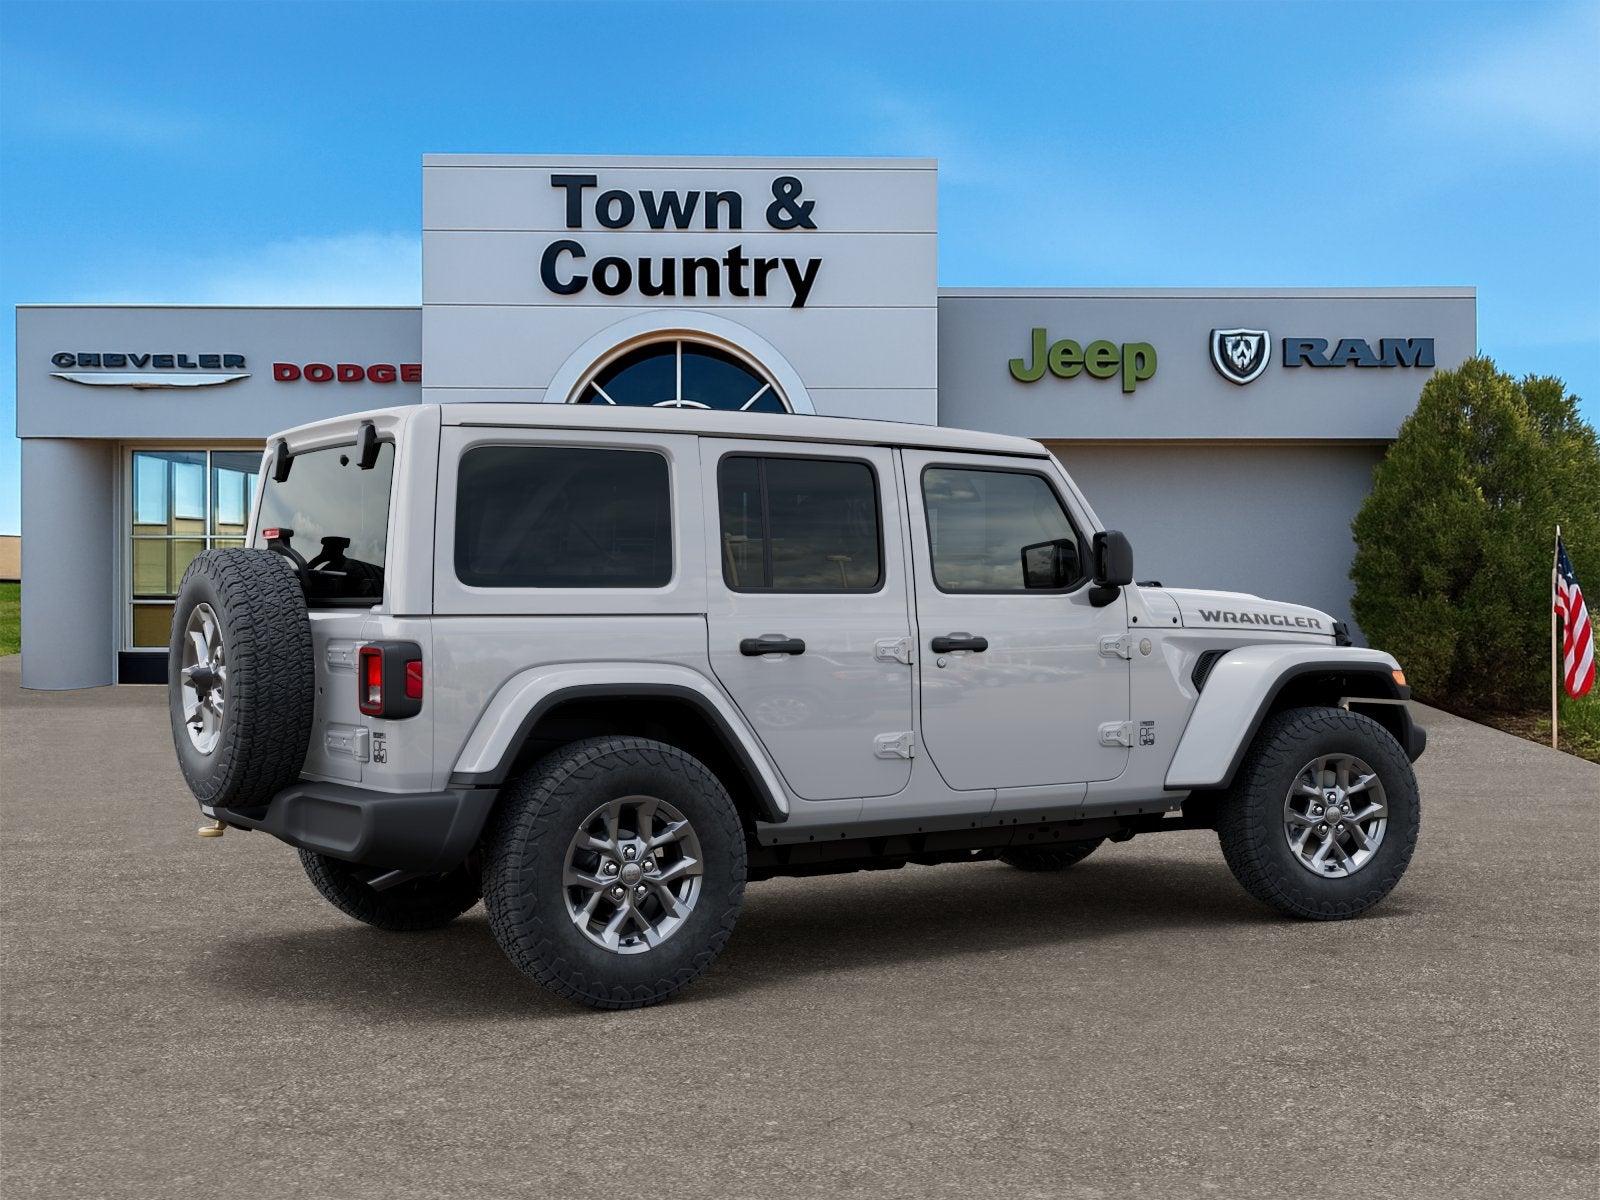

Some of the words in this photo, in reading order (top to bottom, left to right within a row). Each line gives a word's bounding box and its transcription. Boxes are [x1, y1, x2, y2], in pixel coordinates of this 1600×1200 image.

[550, 174, 743, 229] Town
[765, 176, 818, 230] &
[540, 239, 822, 308] Country
[273, 362, 422, 383] DODGE
[1009, 327, 1157, 393] Jeep
[1282, 337, 1436, 368] RAM
[1198, 609, 1322, 629] WRANGLER
